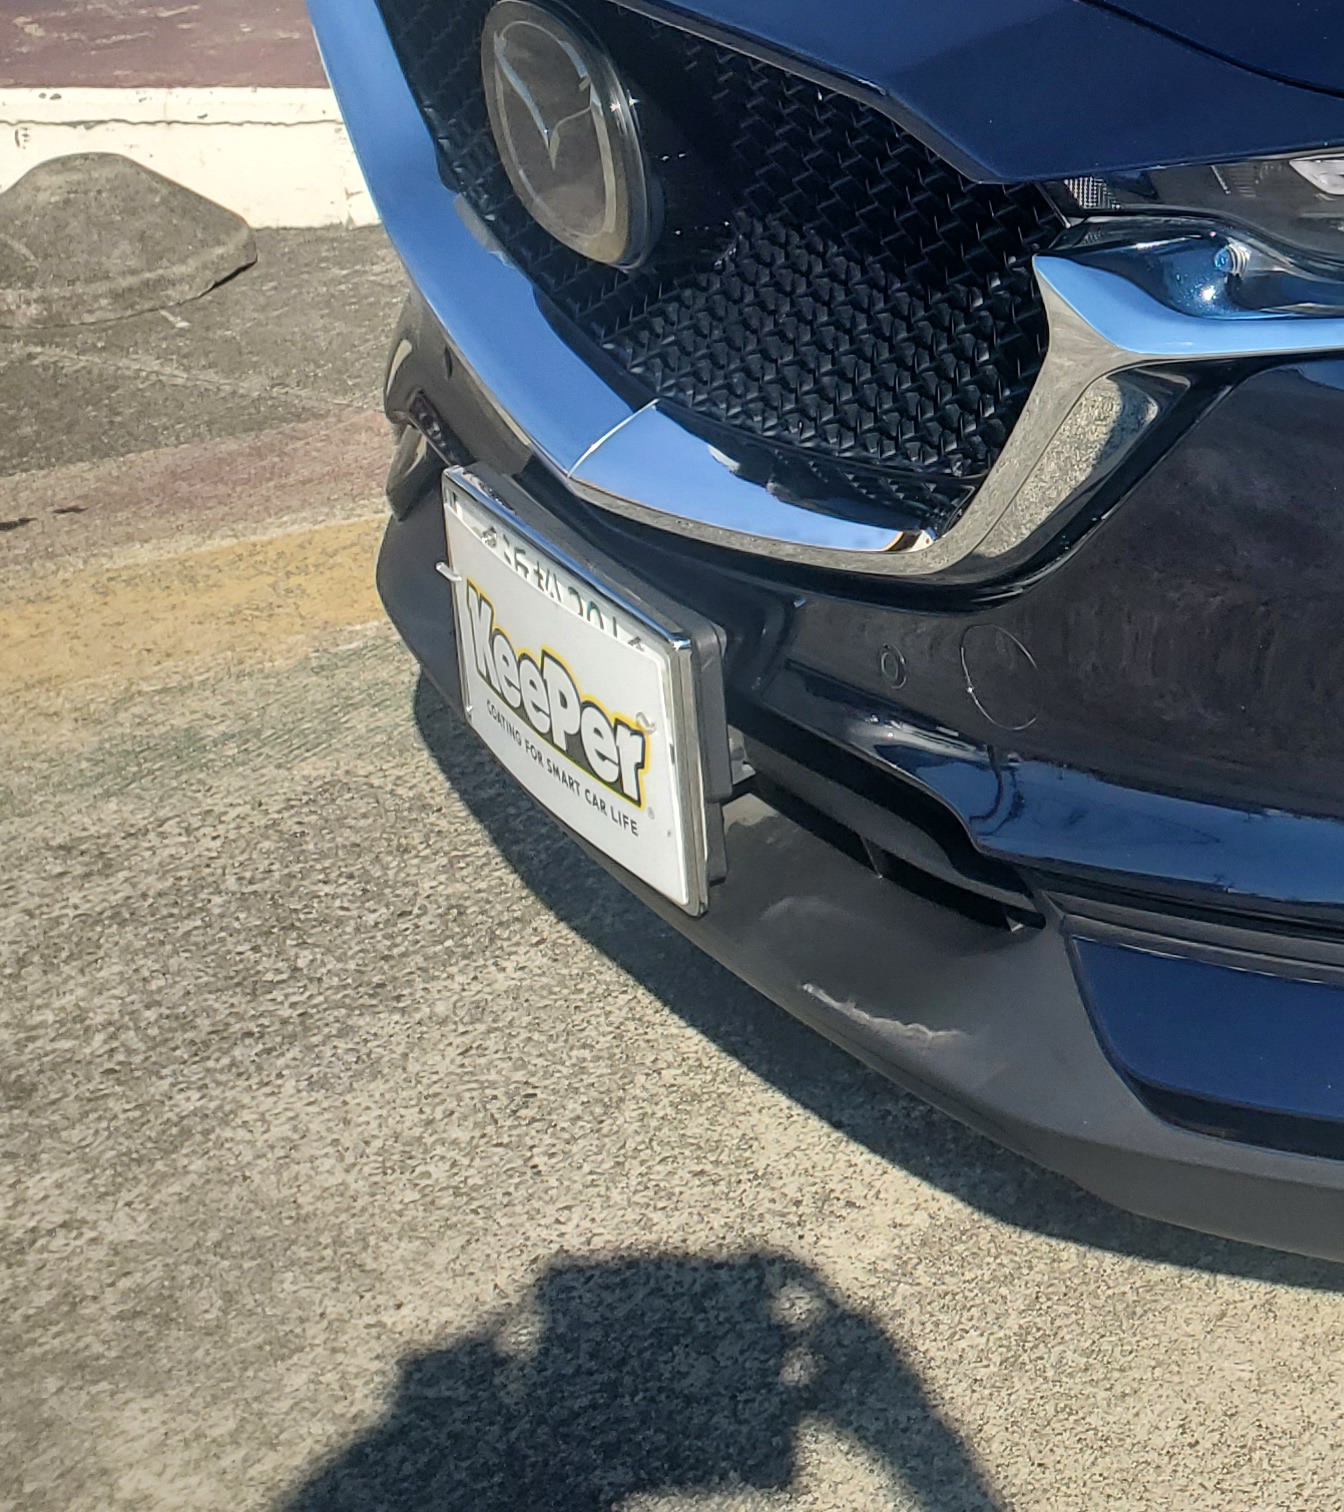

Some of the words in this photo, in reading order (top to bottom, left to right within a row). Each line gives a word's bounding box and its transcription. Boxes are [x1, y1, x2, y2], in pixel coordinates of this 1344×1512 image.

[486, 700, 522, 747] COATING
[525, 740, 545, 766] FOR
[547, 757, 581, 796] SMART
[584, 788, 608, 816] CAR
[610, 805, 640, 837] LIFE
